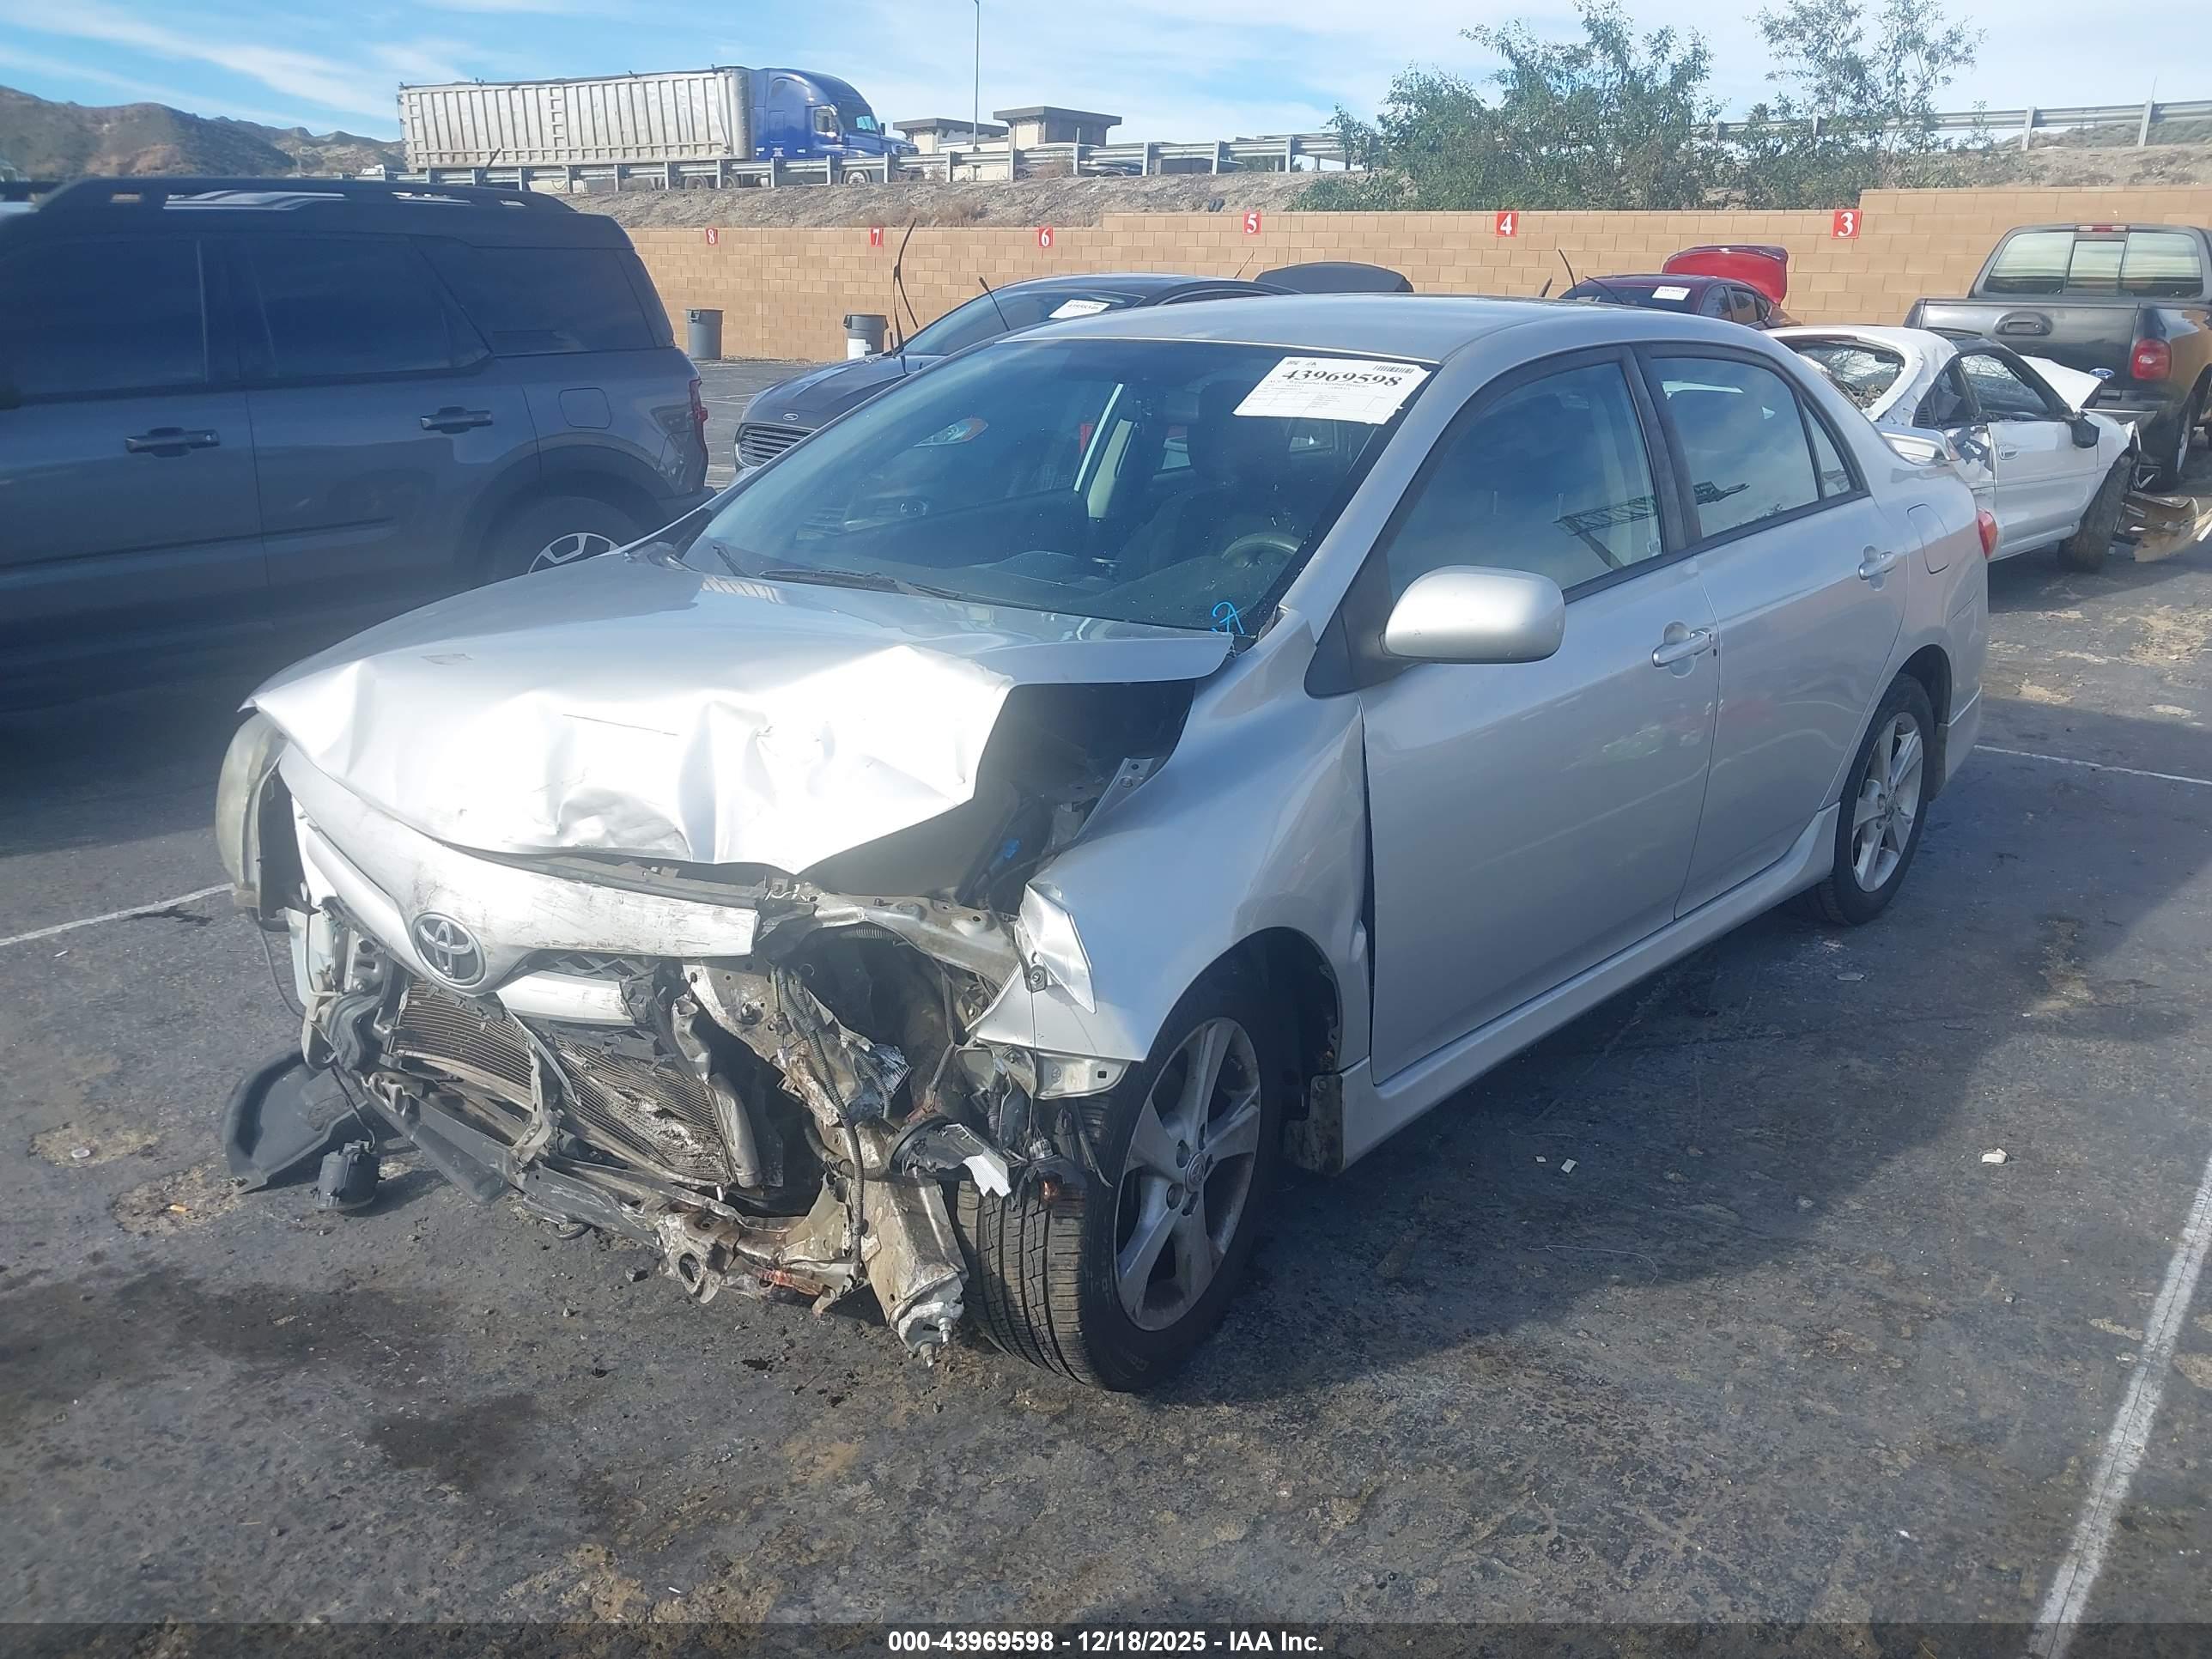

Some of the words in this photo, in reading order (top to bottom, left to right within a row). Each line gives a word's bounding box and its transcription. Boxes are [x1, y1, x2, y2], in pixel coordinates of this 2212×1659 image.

[1246, 213, 1258, 234] 5
[1499, 212, 1513, 235] 4
[1837, 211, 1854, 237] 3
[708, 228, 715, 244] 8
[872, 228, 880, 246] 7
[1041, 228, 1050, 247] 6
[1282, 369, 1402, 387] 43969598
